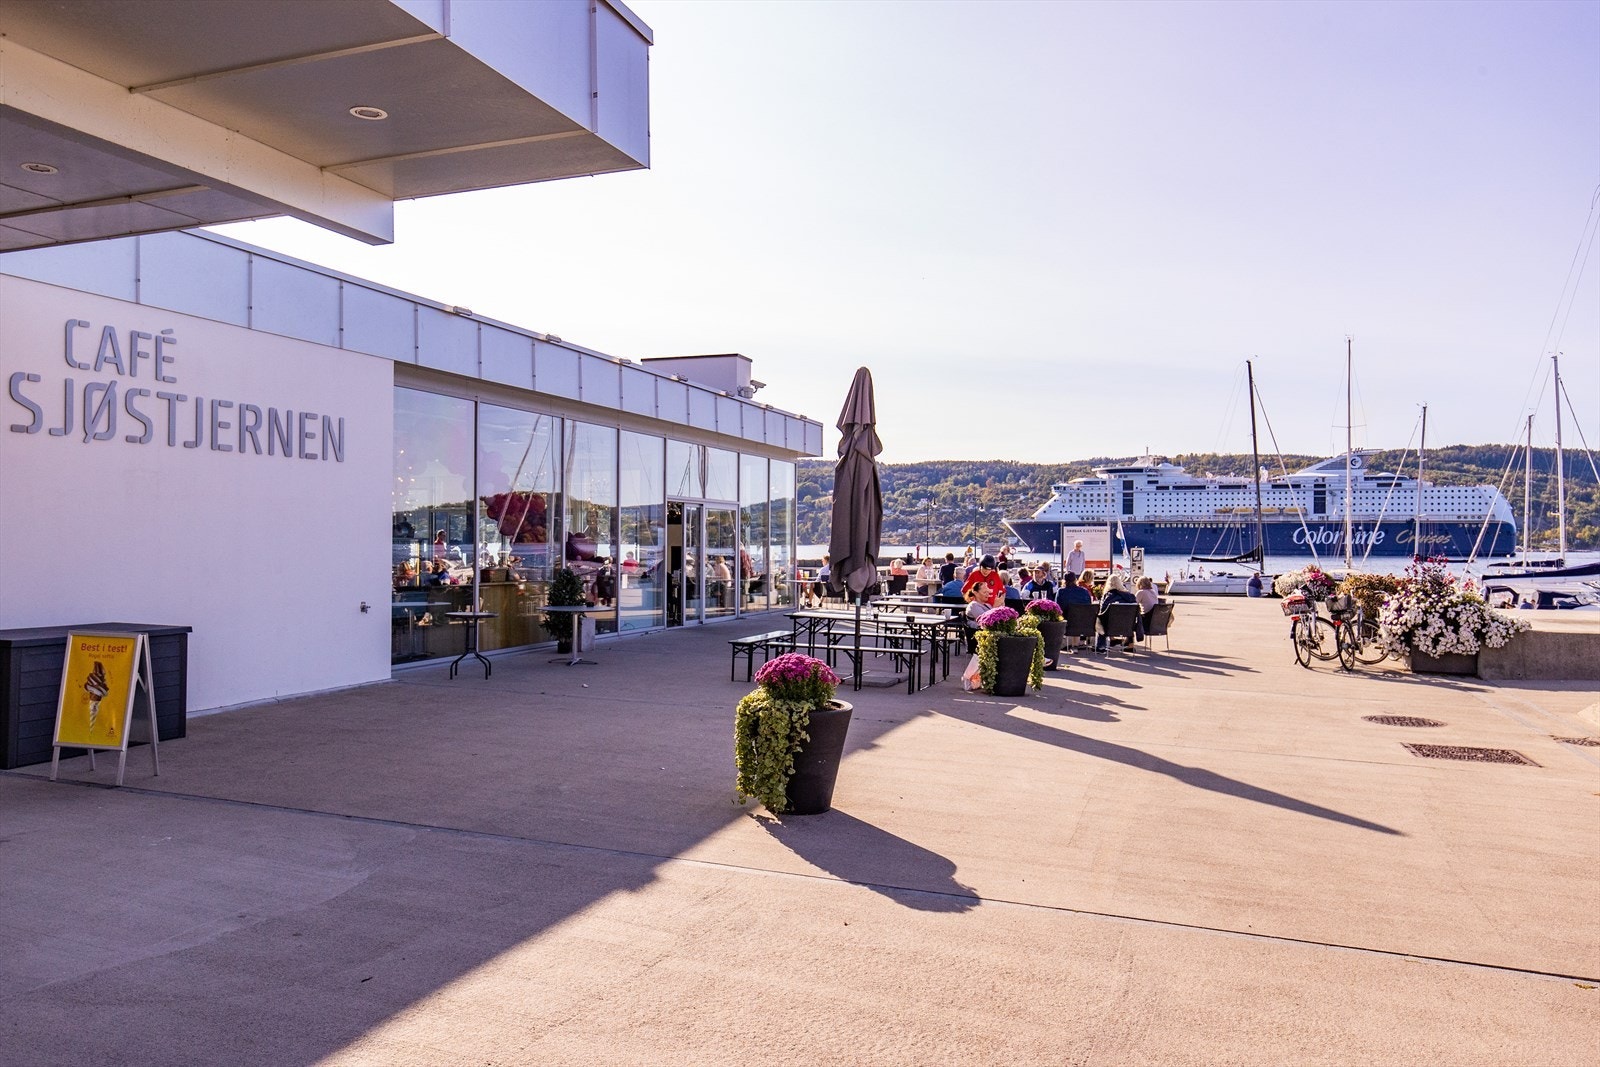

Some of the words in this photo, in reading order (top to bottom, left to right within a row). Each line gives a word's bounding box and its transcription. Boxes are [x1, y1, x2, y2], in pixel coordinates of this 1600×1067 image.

[64, 318, 178, 384] CAFÉ
[8, 371, 346, 463] SJØSTJERNEN
[1292, 526, 1343, 545] Color
[81, 643, 100, 652] Best
[107, 644, 128, 653] test!
